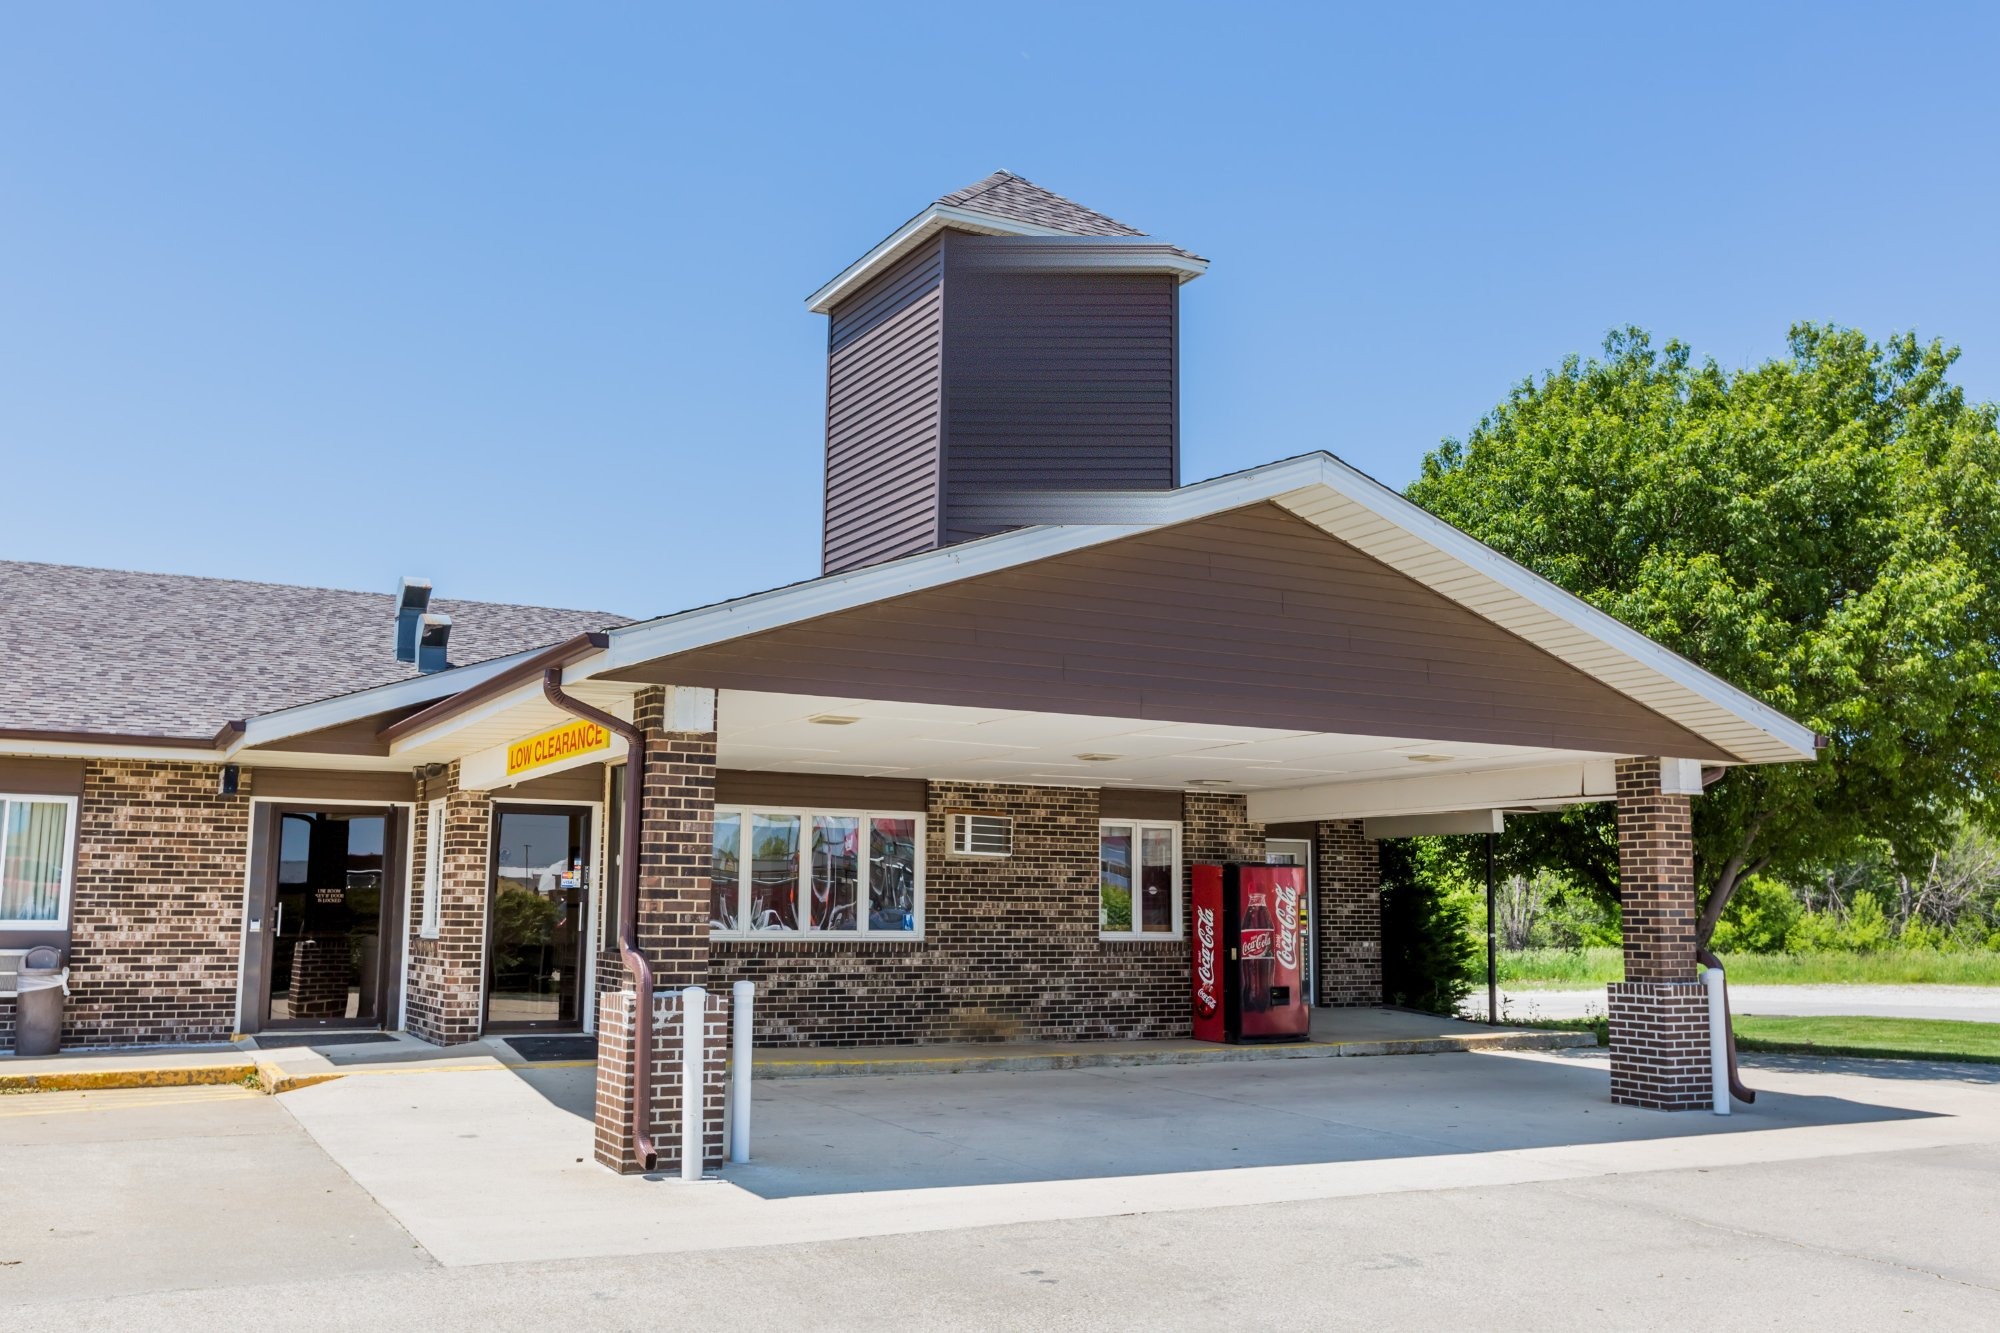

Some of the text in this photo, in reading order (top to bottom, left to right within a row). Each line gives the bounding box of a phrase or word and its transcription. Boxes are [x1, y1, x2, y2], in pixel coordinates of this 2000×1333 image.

[510, 723, 603, 770] LOW CLEARANCE
[1197, 905, 1215, 985] Coca-Cola
[1242, 932, 1271, 956] Coca-Cola
[1275, 882, 1297, 969] Coca-Cola
